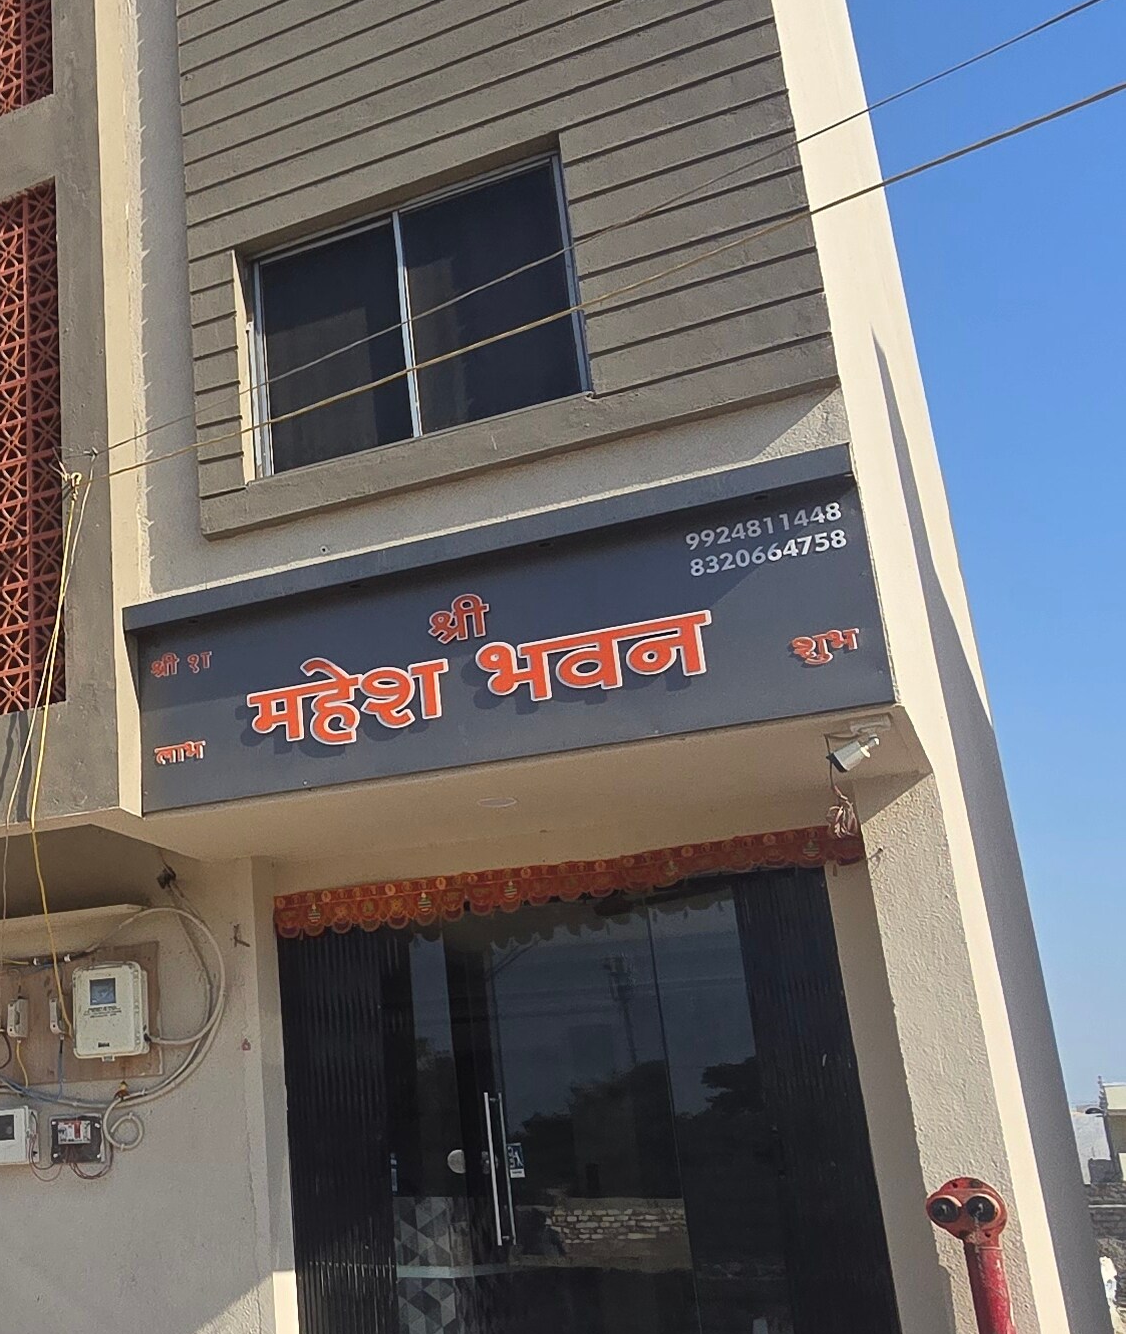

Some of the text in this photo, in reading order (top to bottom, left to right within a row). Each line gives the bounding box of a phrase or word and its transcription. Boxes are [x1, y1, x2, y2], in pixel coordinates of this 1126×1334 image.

[685, 502, 842, 550] 9924811448
[690, 529, 847, 577] 8320664758
[428, 593, 490, 643] श्री
[151, 652, 180, 678] श्री
[791, 628, 860, 665] शुभ
[247, 609, 711, 745] महेश भवन
[154, 740, 207, 765] लाभ
